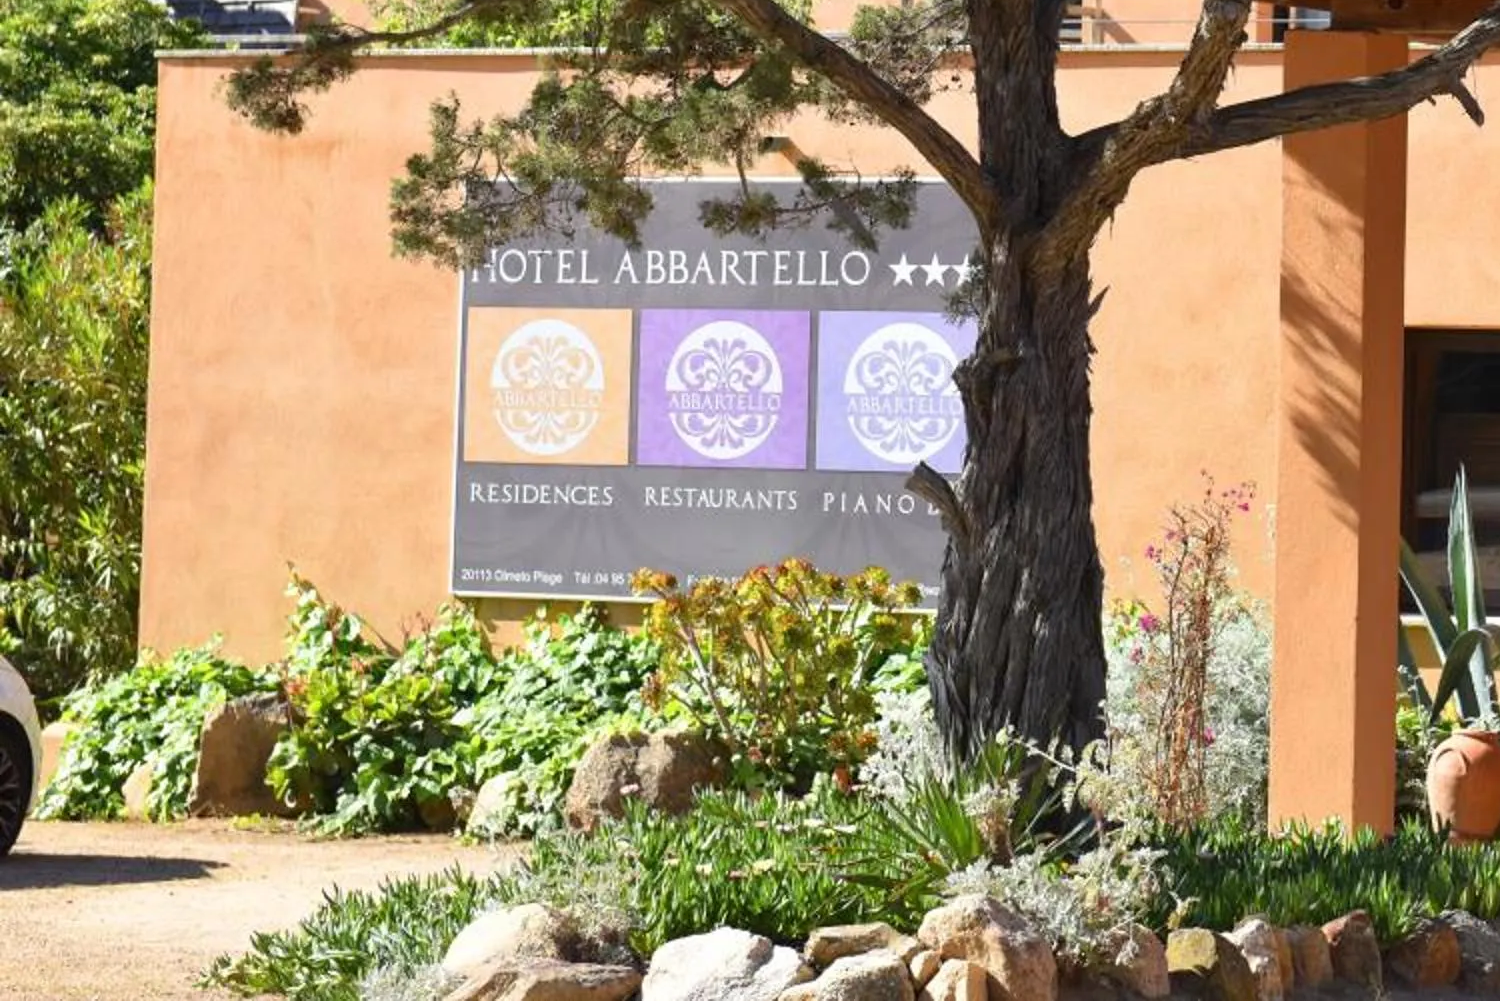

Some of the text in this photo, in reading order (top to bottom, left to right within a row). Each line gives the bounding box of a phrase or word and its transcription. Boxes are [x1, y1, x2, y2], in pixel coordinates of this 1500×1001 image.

[471, 249, 871, 286] HOTEL ABBARTELLO
[668, 391, 781, 411] ABBARTELLO
[847, 394, 963, 415] ABBARTELLO
[469, 482, 614, 506] RESIDENCES
[645, 485, 798, 511] RESTAURANTS
[823, 492, 915, 515] PIANO
[461, 568, 491, 582] 20113
[533, 570, 563, 587] Plage
